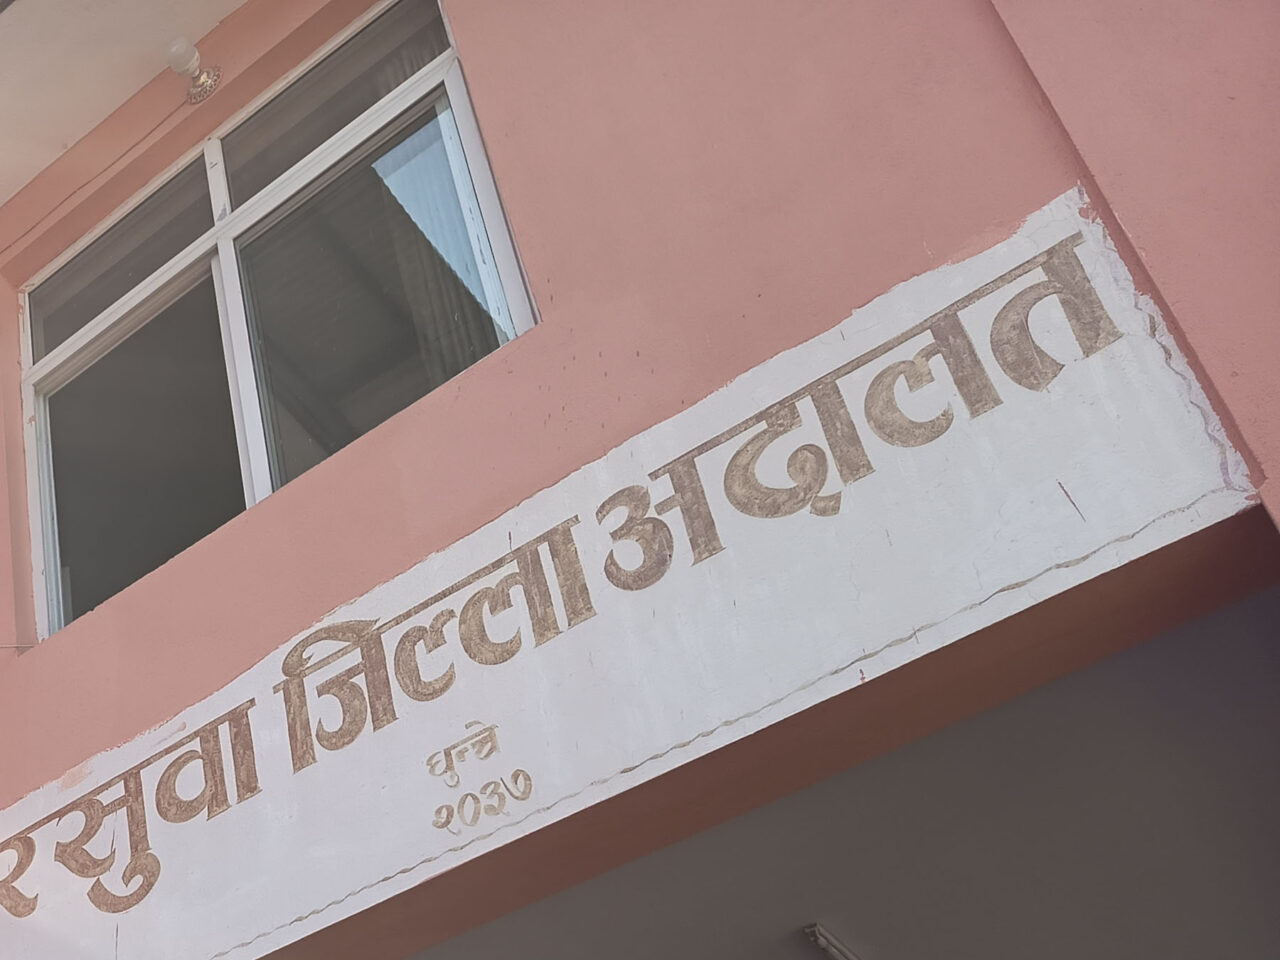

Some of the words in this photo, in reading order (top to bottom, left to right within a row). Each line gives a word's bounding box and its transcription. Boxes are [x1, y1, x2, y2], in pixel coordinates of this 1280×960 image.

[272, 514, 599, 775] जिल्ला
[595, 230, 1124, 592] अदालत
[432, 768, 532, 836] २०३७
